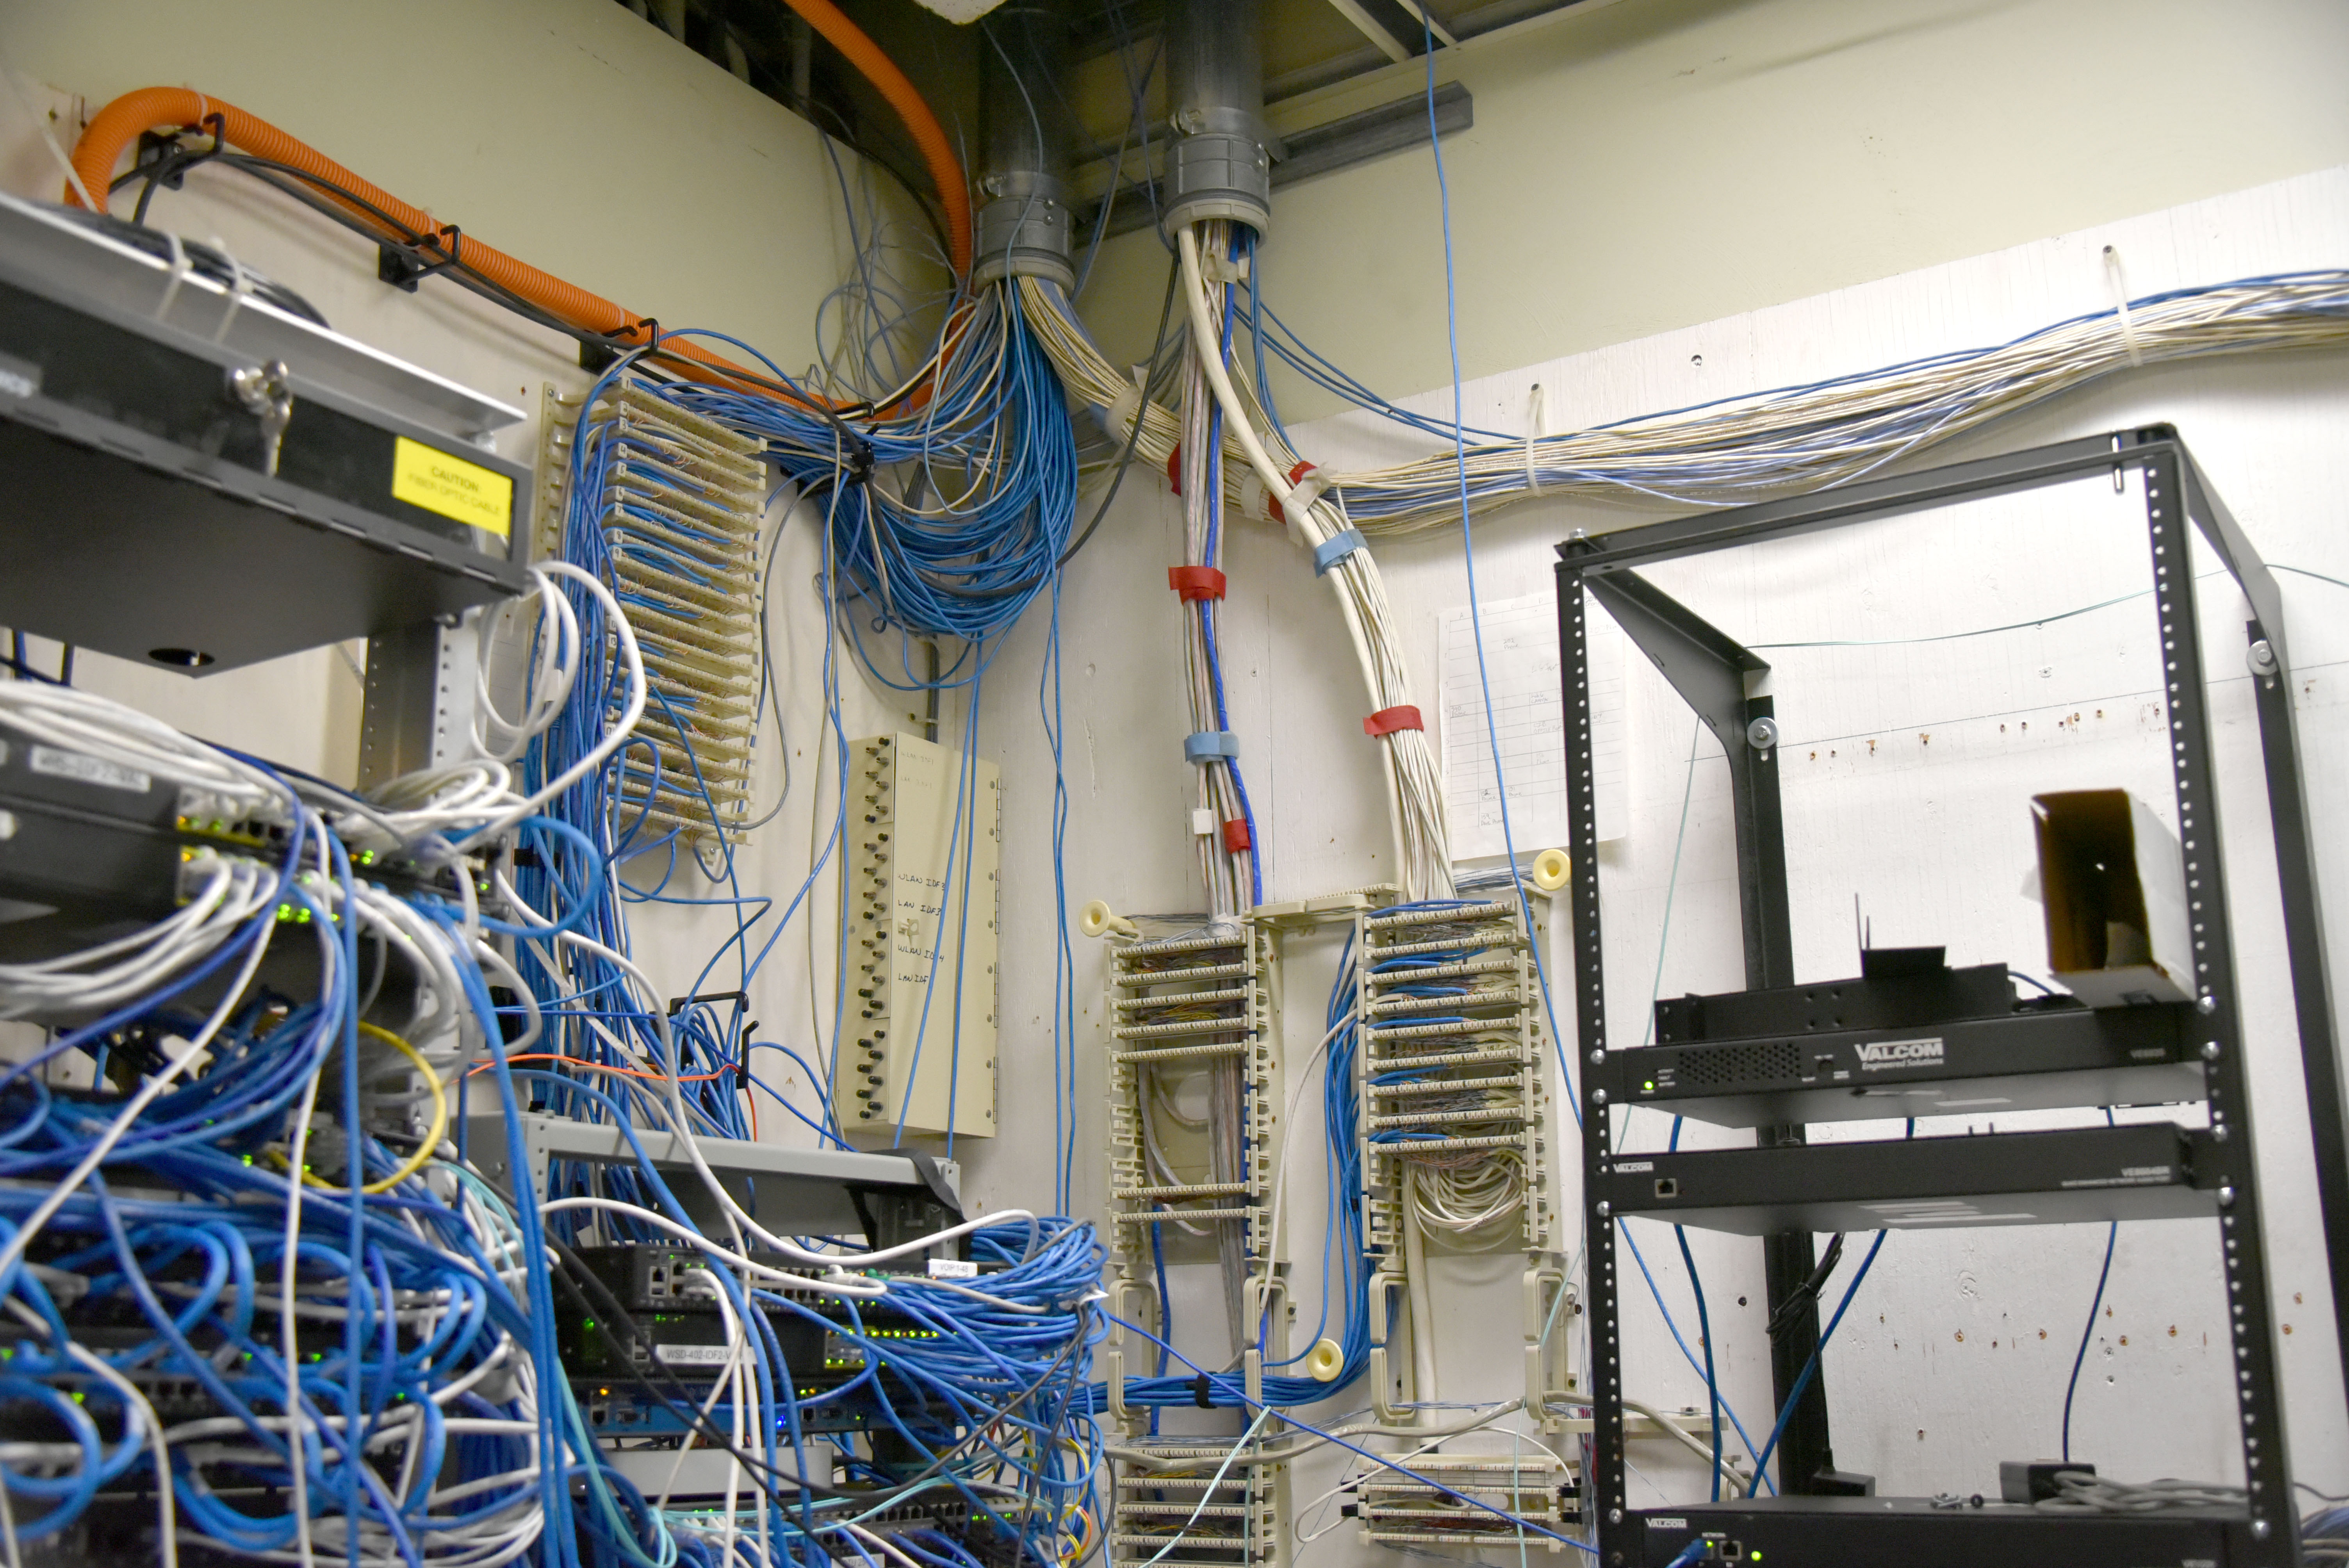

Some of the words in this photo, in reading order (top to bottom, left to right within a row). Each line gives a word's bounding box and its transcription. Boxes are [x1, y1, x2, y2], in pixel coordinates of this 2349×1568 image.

[898, 873, 923, 884] WLAN
[898, 899, 914, 908] LAN
[920, 905, 942, 916] IDF3
[898, 944, 921, 955] WLAN
[924, 950, 944, 962] ID4
[898, 973, 913, 982] LAN
[1854, 1037, 1943, 1062] VALCOM
[1862, 1060, 1905, 1071] Engineered
[1907, 1058, 1944, 1067] Solutions
[1613, 1161, 1654, 1174] VALCOM
[1645, 1518, 1687, 1529] VALCOM
